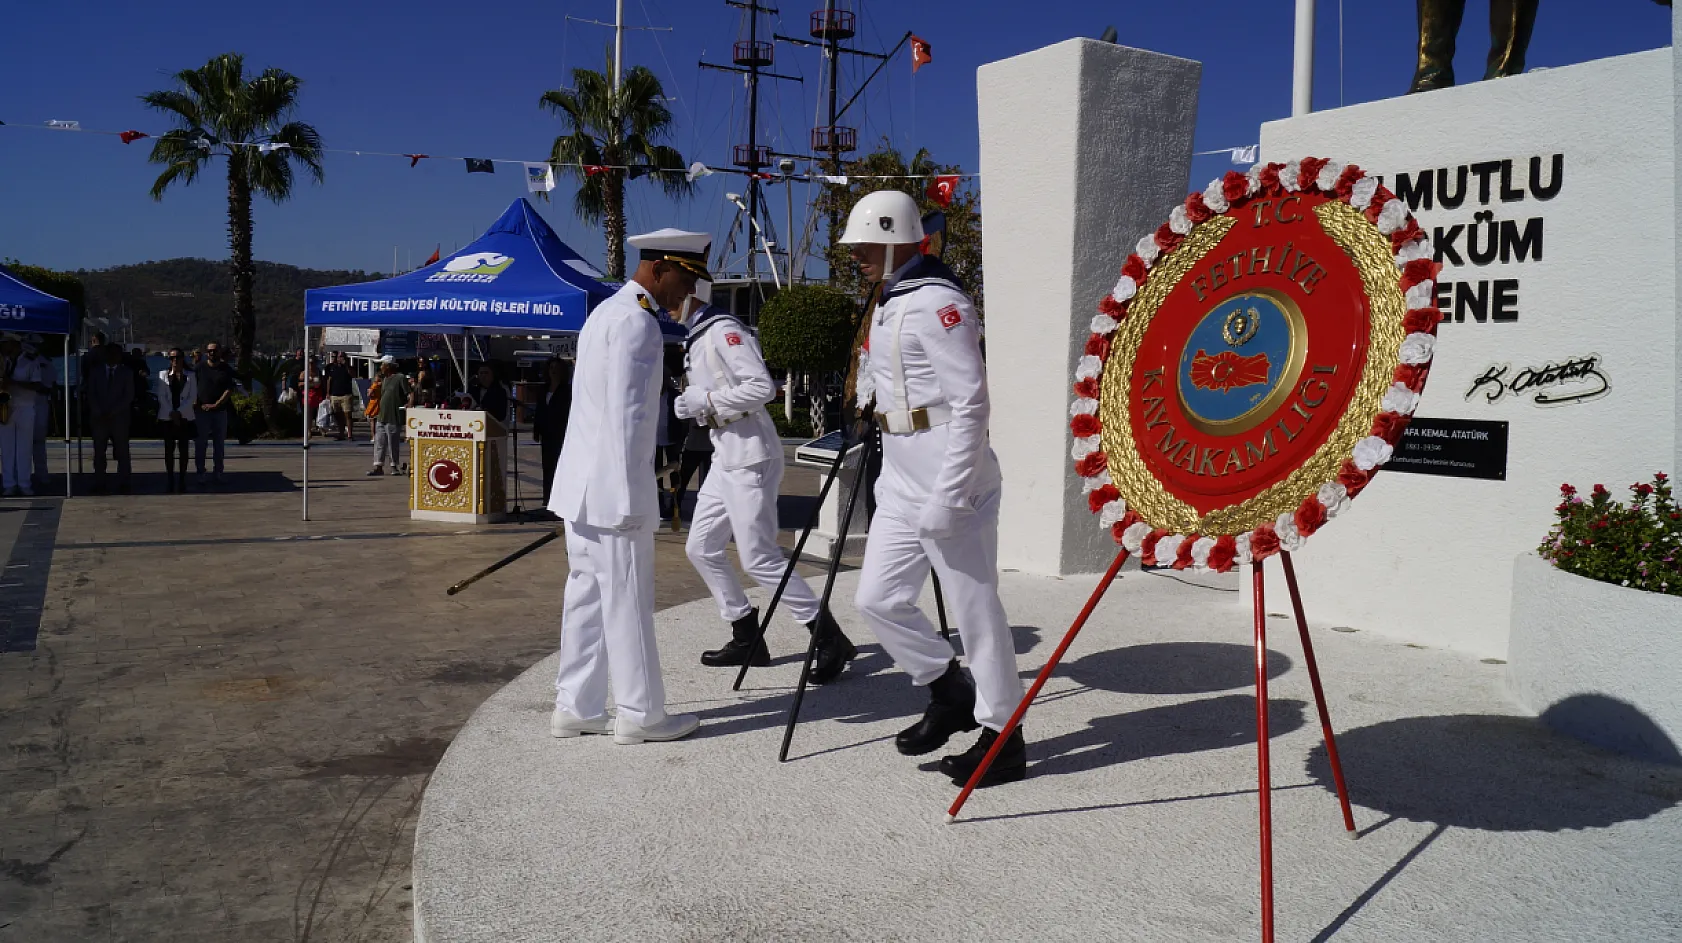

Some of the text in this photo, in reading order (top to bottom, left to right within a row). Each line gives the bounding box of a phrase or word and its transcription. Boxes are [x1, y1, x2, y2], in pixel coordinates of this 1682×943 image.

[1396, 153, 1564, 212] MUTLU
[1250, 195, 1304, 229] T.C.
[1190, 241, 1328, 302] FETHİYE
[321, 297, 564, 316] FETHİYE BELEDİYESİ KÜLTÜR İŞLERİ MÜD.
[1142, 363, 1339, 478] KAYMAKAMLIĞI
[1421, 429, 1450, 439] KEMAL
[1450, 429, 1489, 441] ATATÜRK
